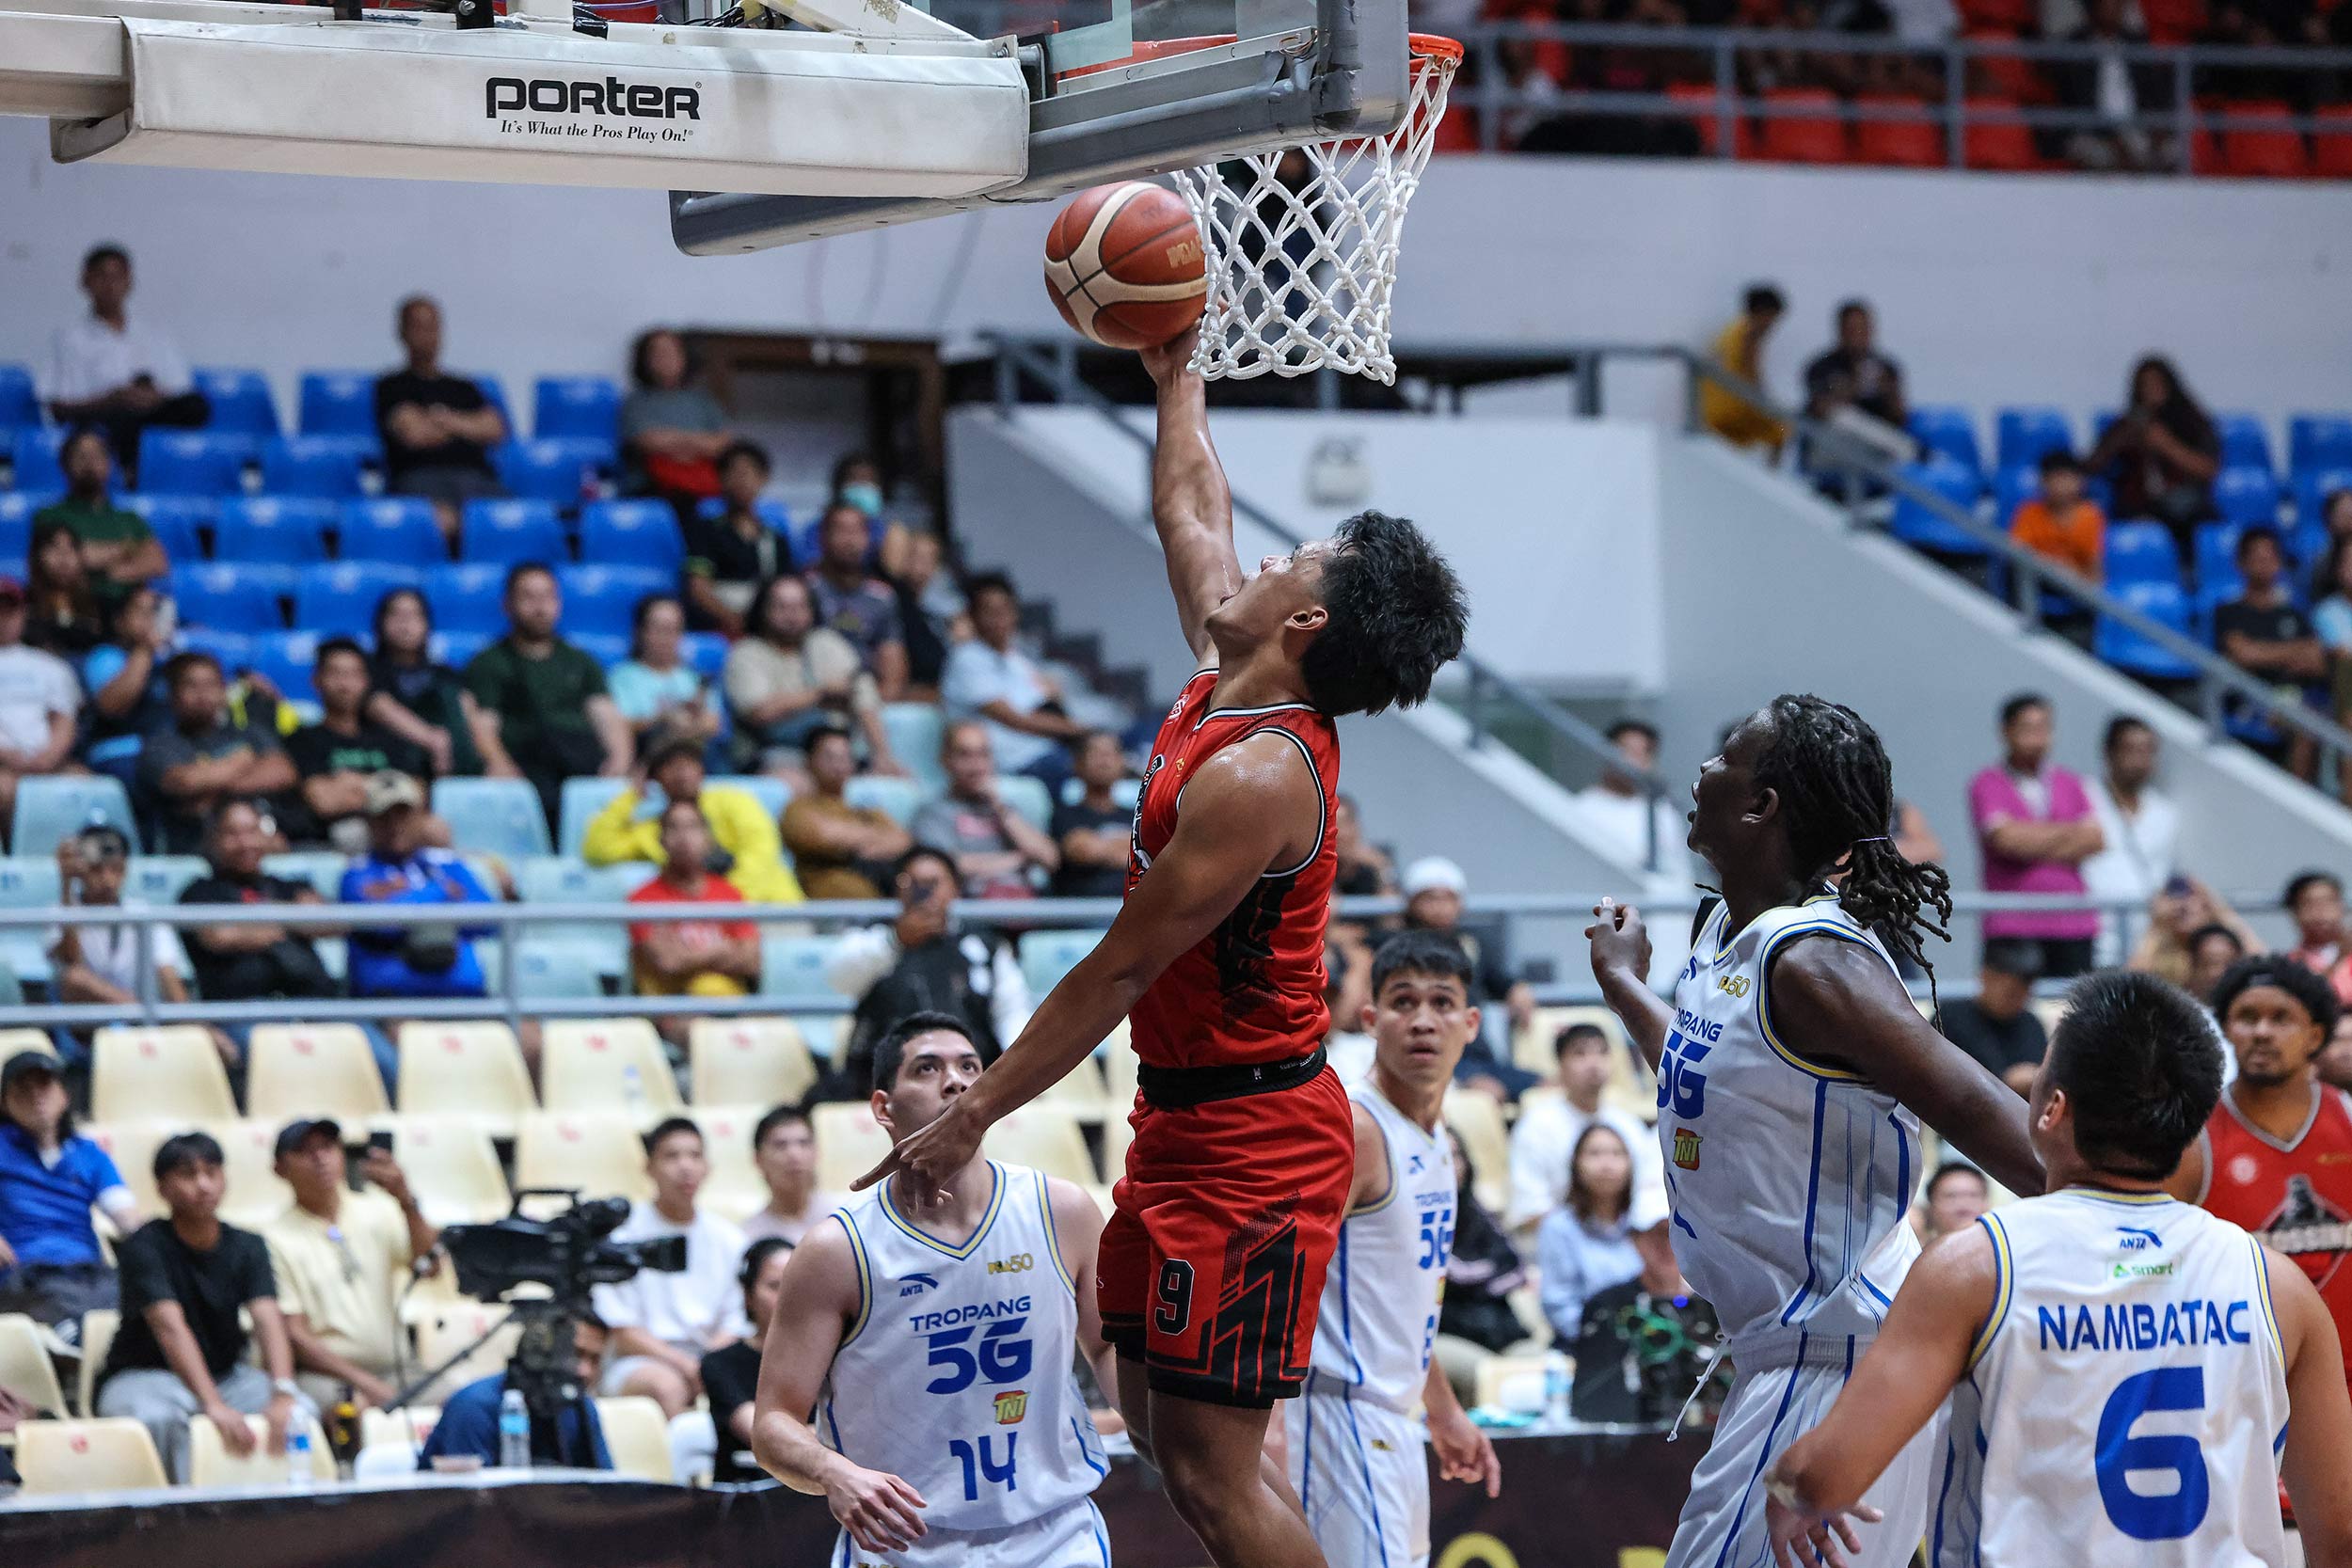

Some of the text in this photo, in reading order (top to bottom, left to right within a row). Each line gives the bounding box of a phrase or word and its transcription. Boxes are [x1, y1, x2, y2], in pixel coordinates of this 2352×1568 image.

[501, 119, 689, 143] It's What the Pros Play On!
[1673, 1134, 1704, 1163] TNT
[899, 1284, 924, 1297] ANTA
[1154, 1258, 1195, 1336] 9
[910, 1295, 1031, 1332] TROPANG
[2038, 1300, 2251, 1352] NAMBATAC
[926, 1317, 1033, 1395] 5G
[993, 1391, 1031, 1423] TNT
[948, 1432, 1018, 1501] 14
[2095, 1366, 2209, 1543] 6
